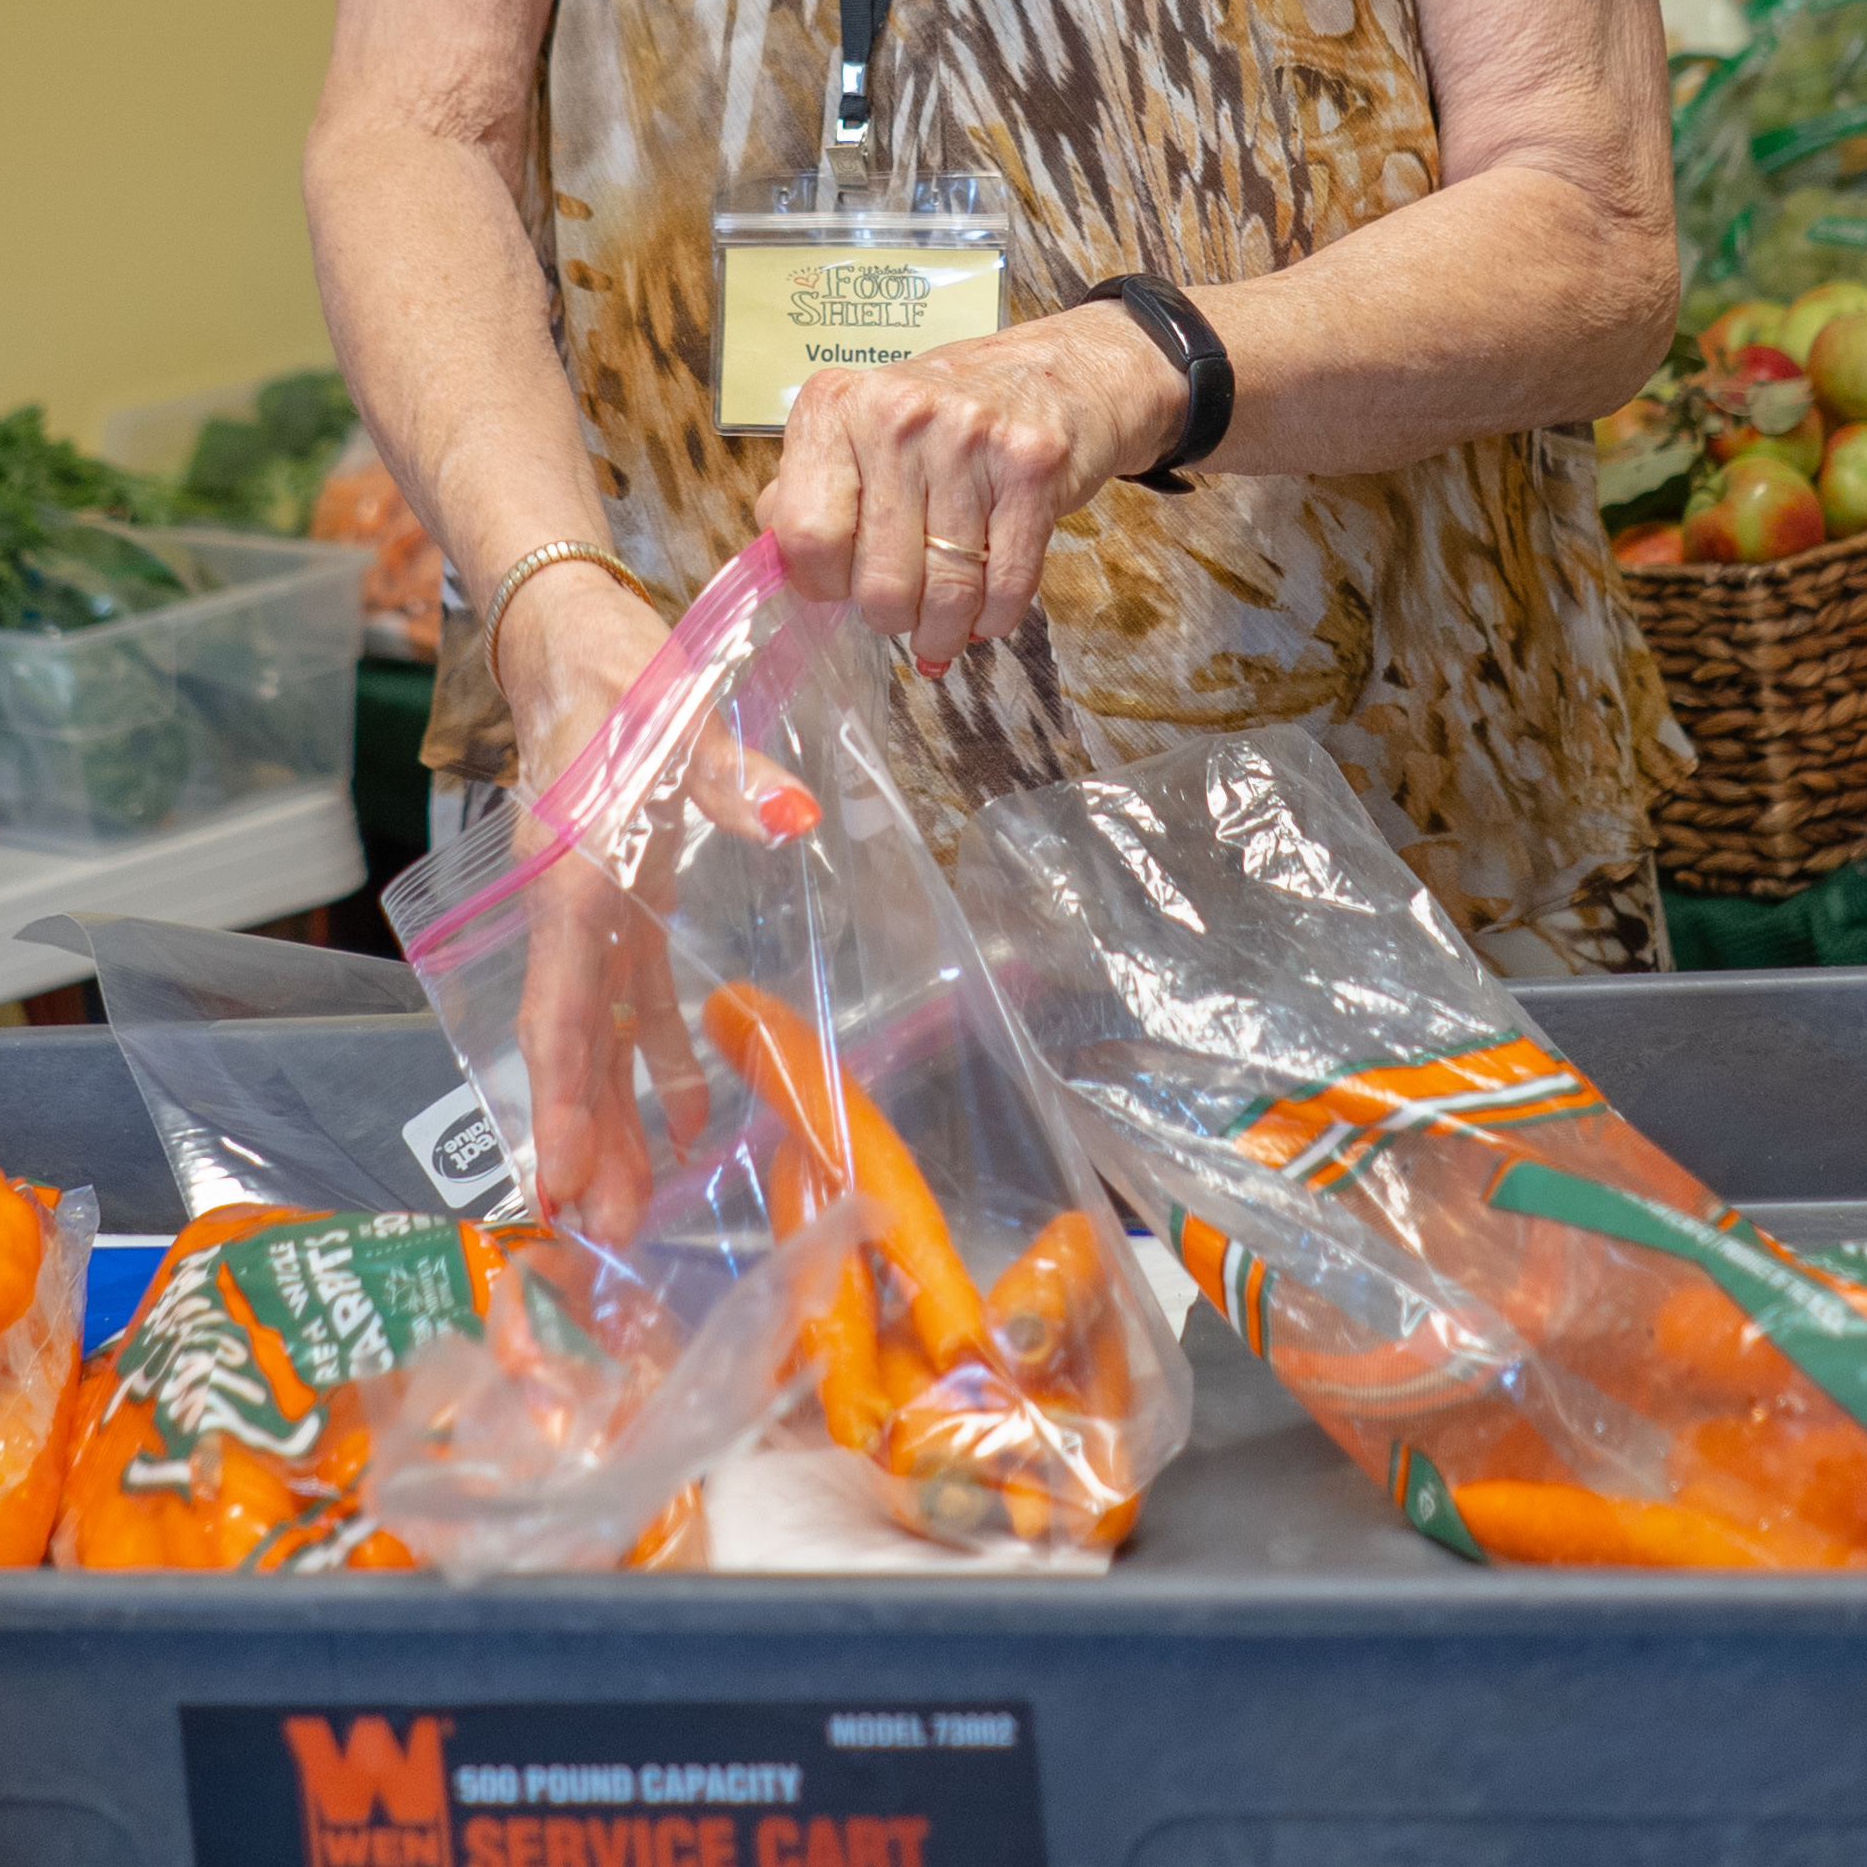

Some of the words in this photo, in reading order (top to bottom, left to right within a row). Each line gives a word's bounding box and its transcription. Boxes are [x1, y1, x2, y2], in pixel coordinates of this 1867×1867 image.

[819, 266, 931, 300] FOOD
[787, 291, 927, 328] SHELF
[806, 344, 912, 364] Volunteer
[829, 1712, 928, 1749] MODEL
[456, 1763, 520, 1804] 500
[524, 1763, 635, 1804] POUND
[639, 1762, 802, 1804] CAPACITY
[319, 1827, 441, 1867] WEN
[462, 1815, 737, 1867] SERVICE
[754, 1815, 929, 1867] CART
